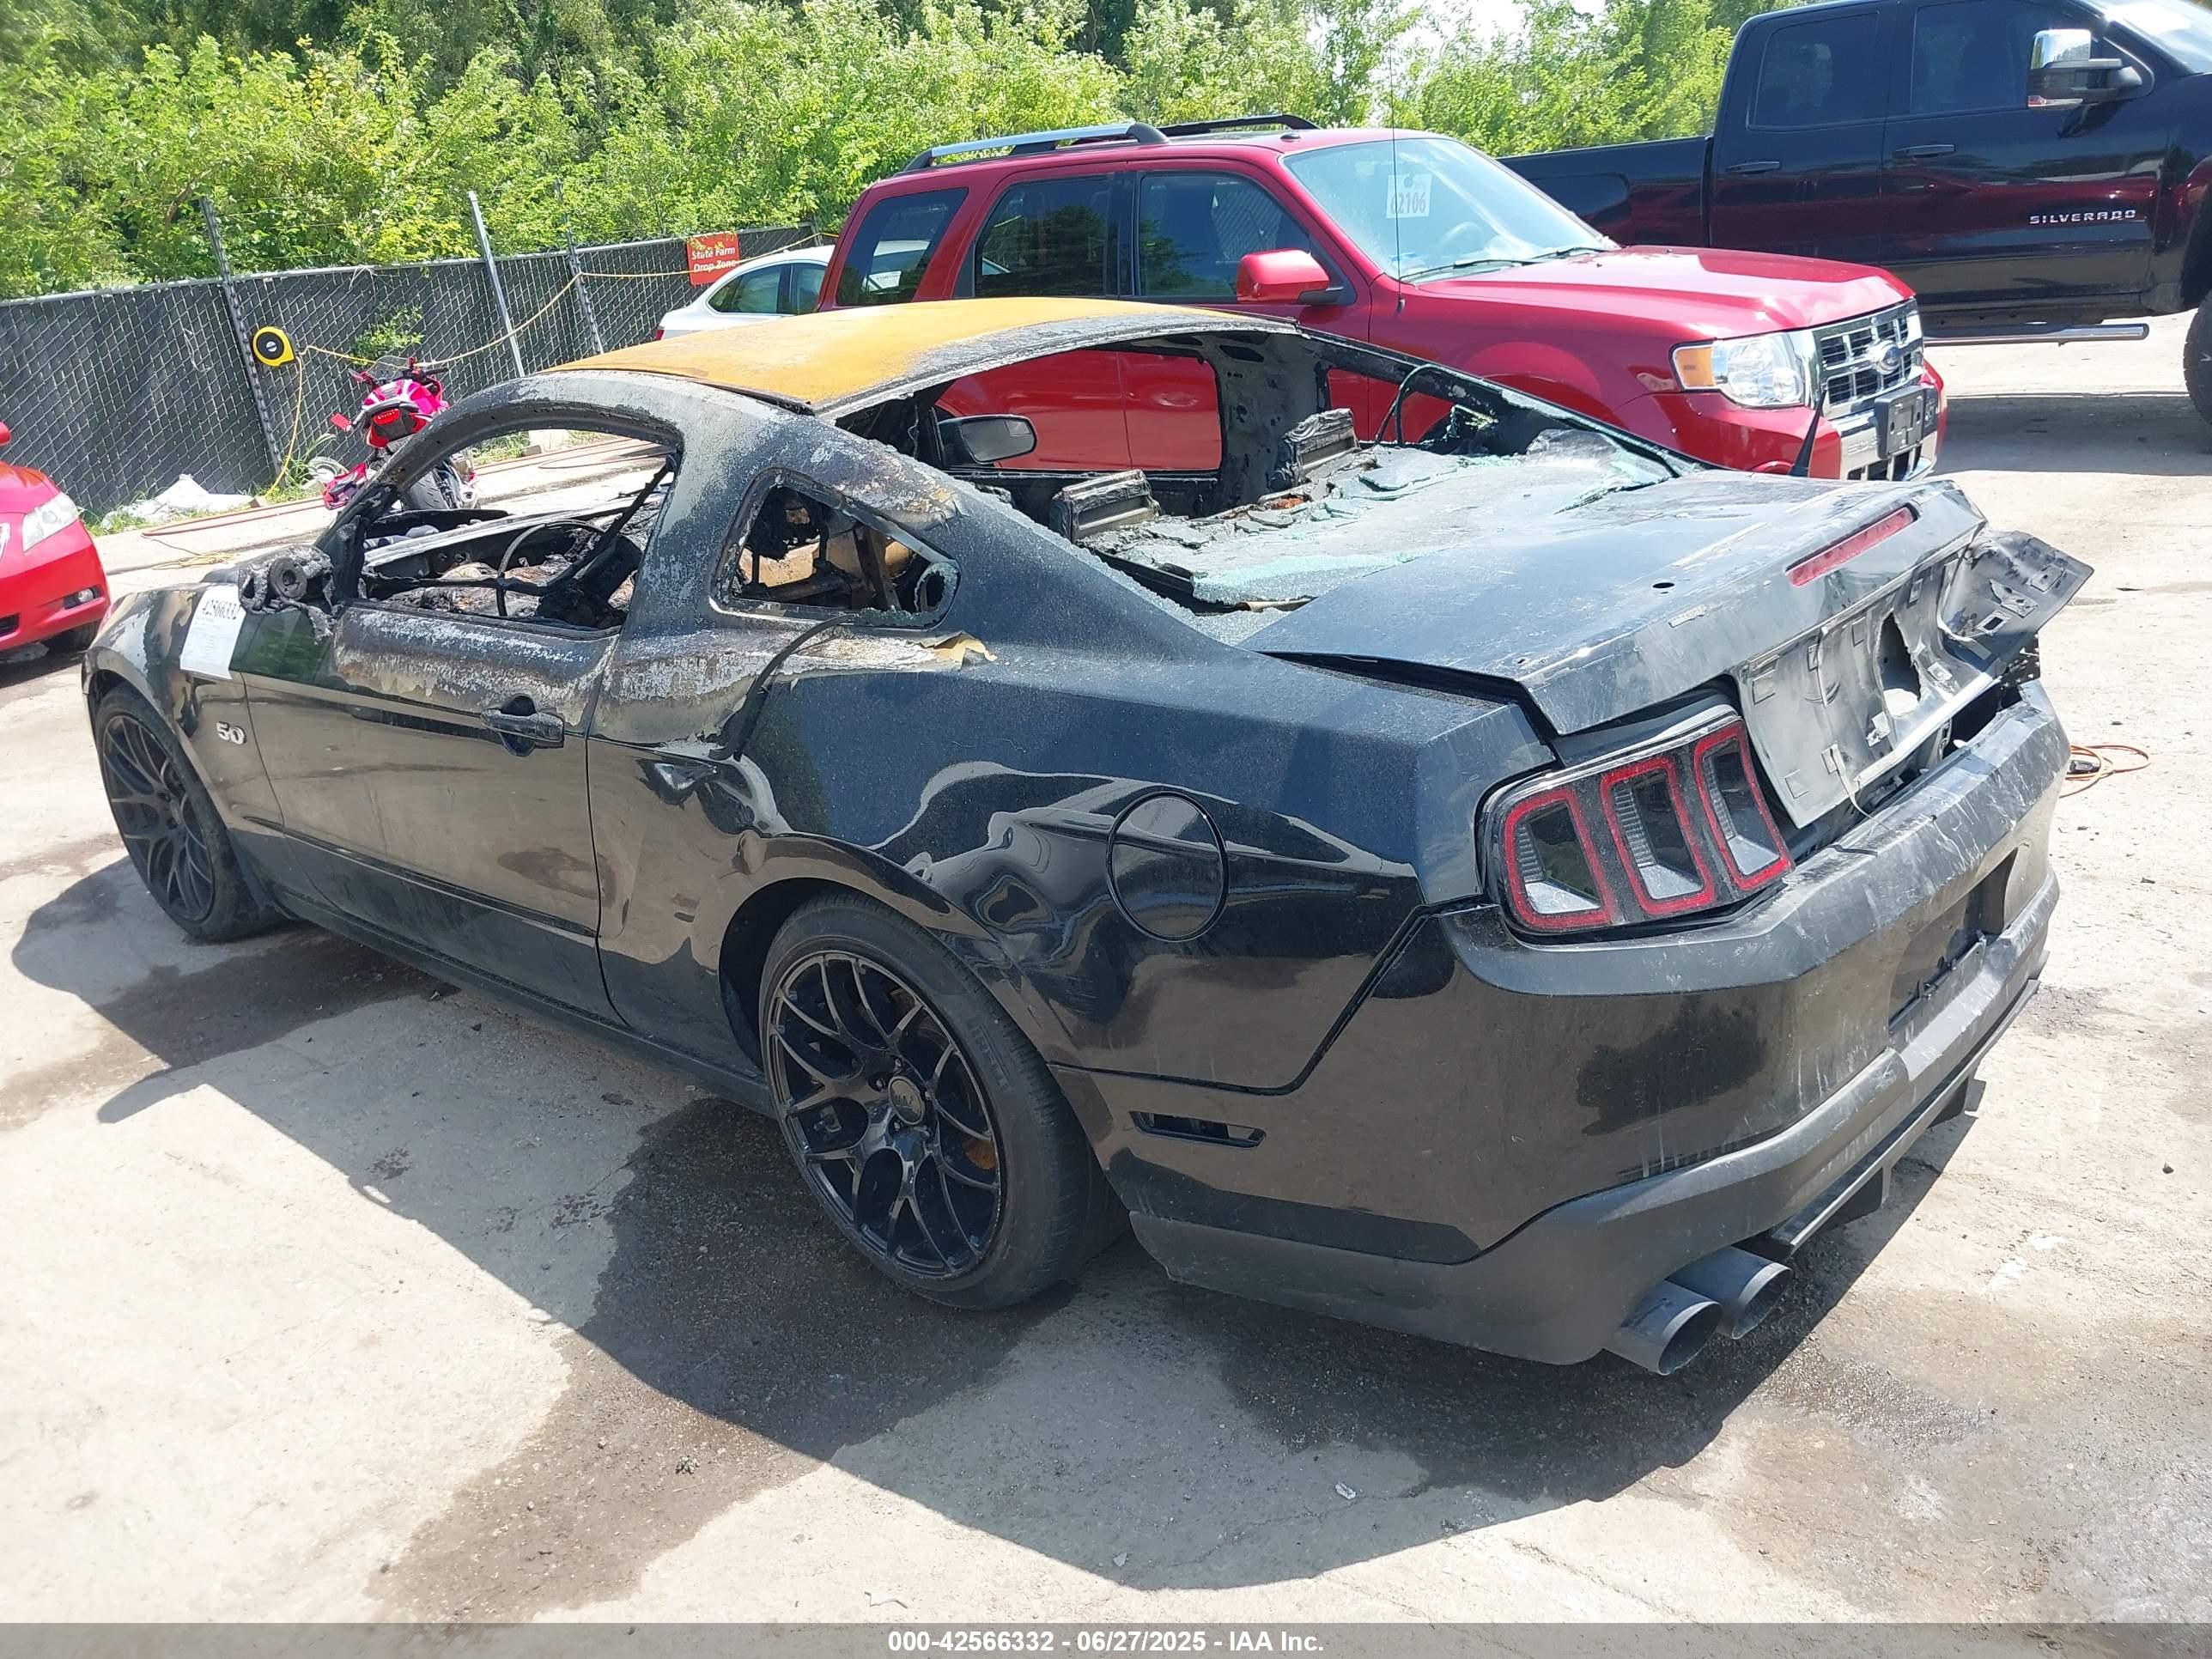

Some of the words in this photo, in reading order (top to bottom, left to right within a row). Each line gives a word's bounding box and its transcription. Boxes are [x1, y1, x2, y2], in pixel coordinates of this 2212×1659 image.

[1390, 192, 1426, 214] 62106
[2029, 210, 2136, 223] SILVERADO
[691, 248, 714, 260] State
[715, 247, 736, 257] Farm
[694, 263, 714, 272] Drop
[716, 259, 736, 269] Zone
